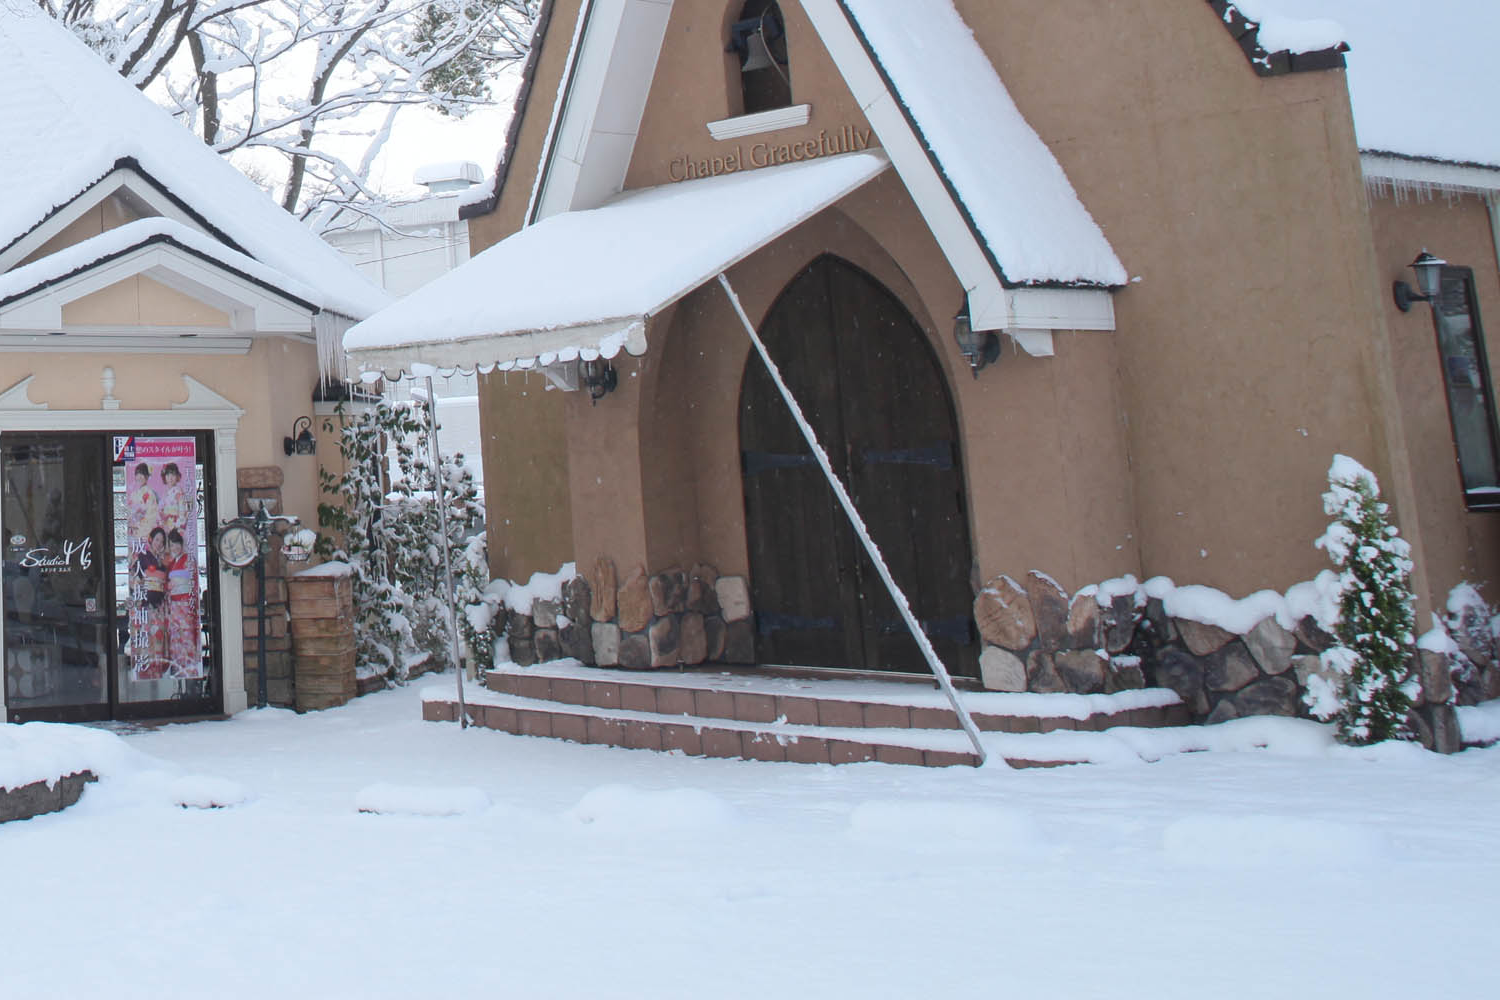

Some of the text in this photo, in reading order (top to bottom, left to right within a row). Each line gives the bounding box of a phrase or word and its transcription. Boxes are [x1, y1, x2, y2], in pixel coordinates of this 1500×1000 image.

[668, 125, 871, 182] Chapel Gracefully
[19, 548, 65, 567] Studio
